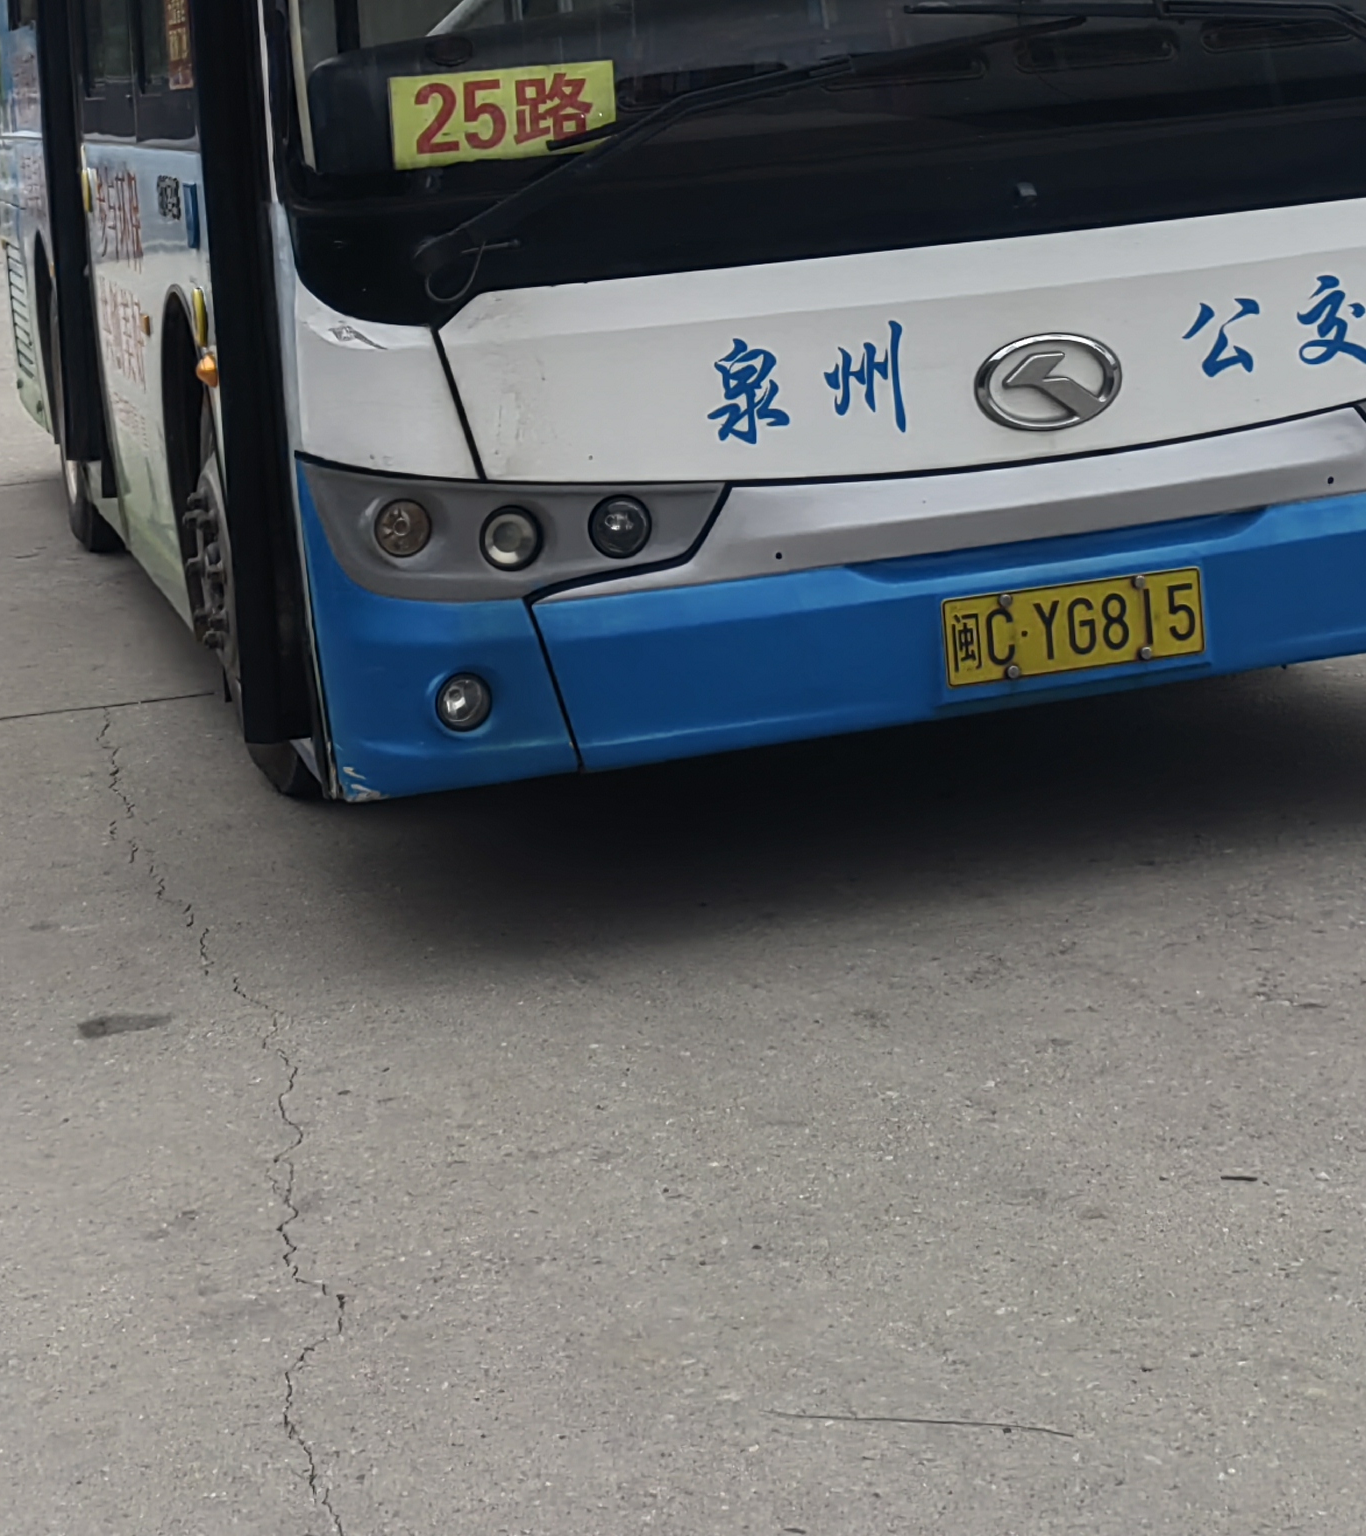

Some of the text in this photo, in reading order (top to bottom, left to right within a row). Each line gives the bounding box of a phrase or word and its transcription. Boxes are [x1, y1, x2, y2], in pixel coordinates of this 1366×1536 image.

[414, 72, 593, 155] 25路
[707, 320, 907, 445] 泉州
[951, 582, 1196, 673] 闽C·YG815
